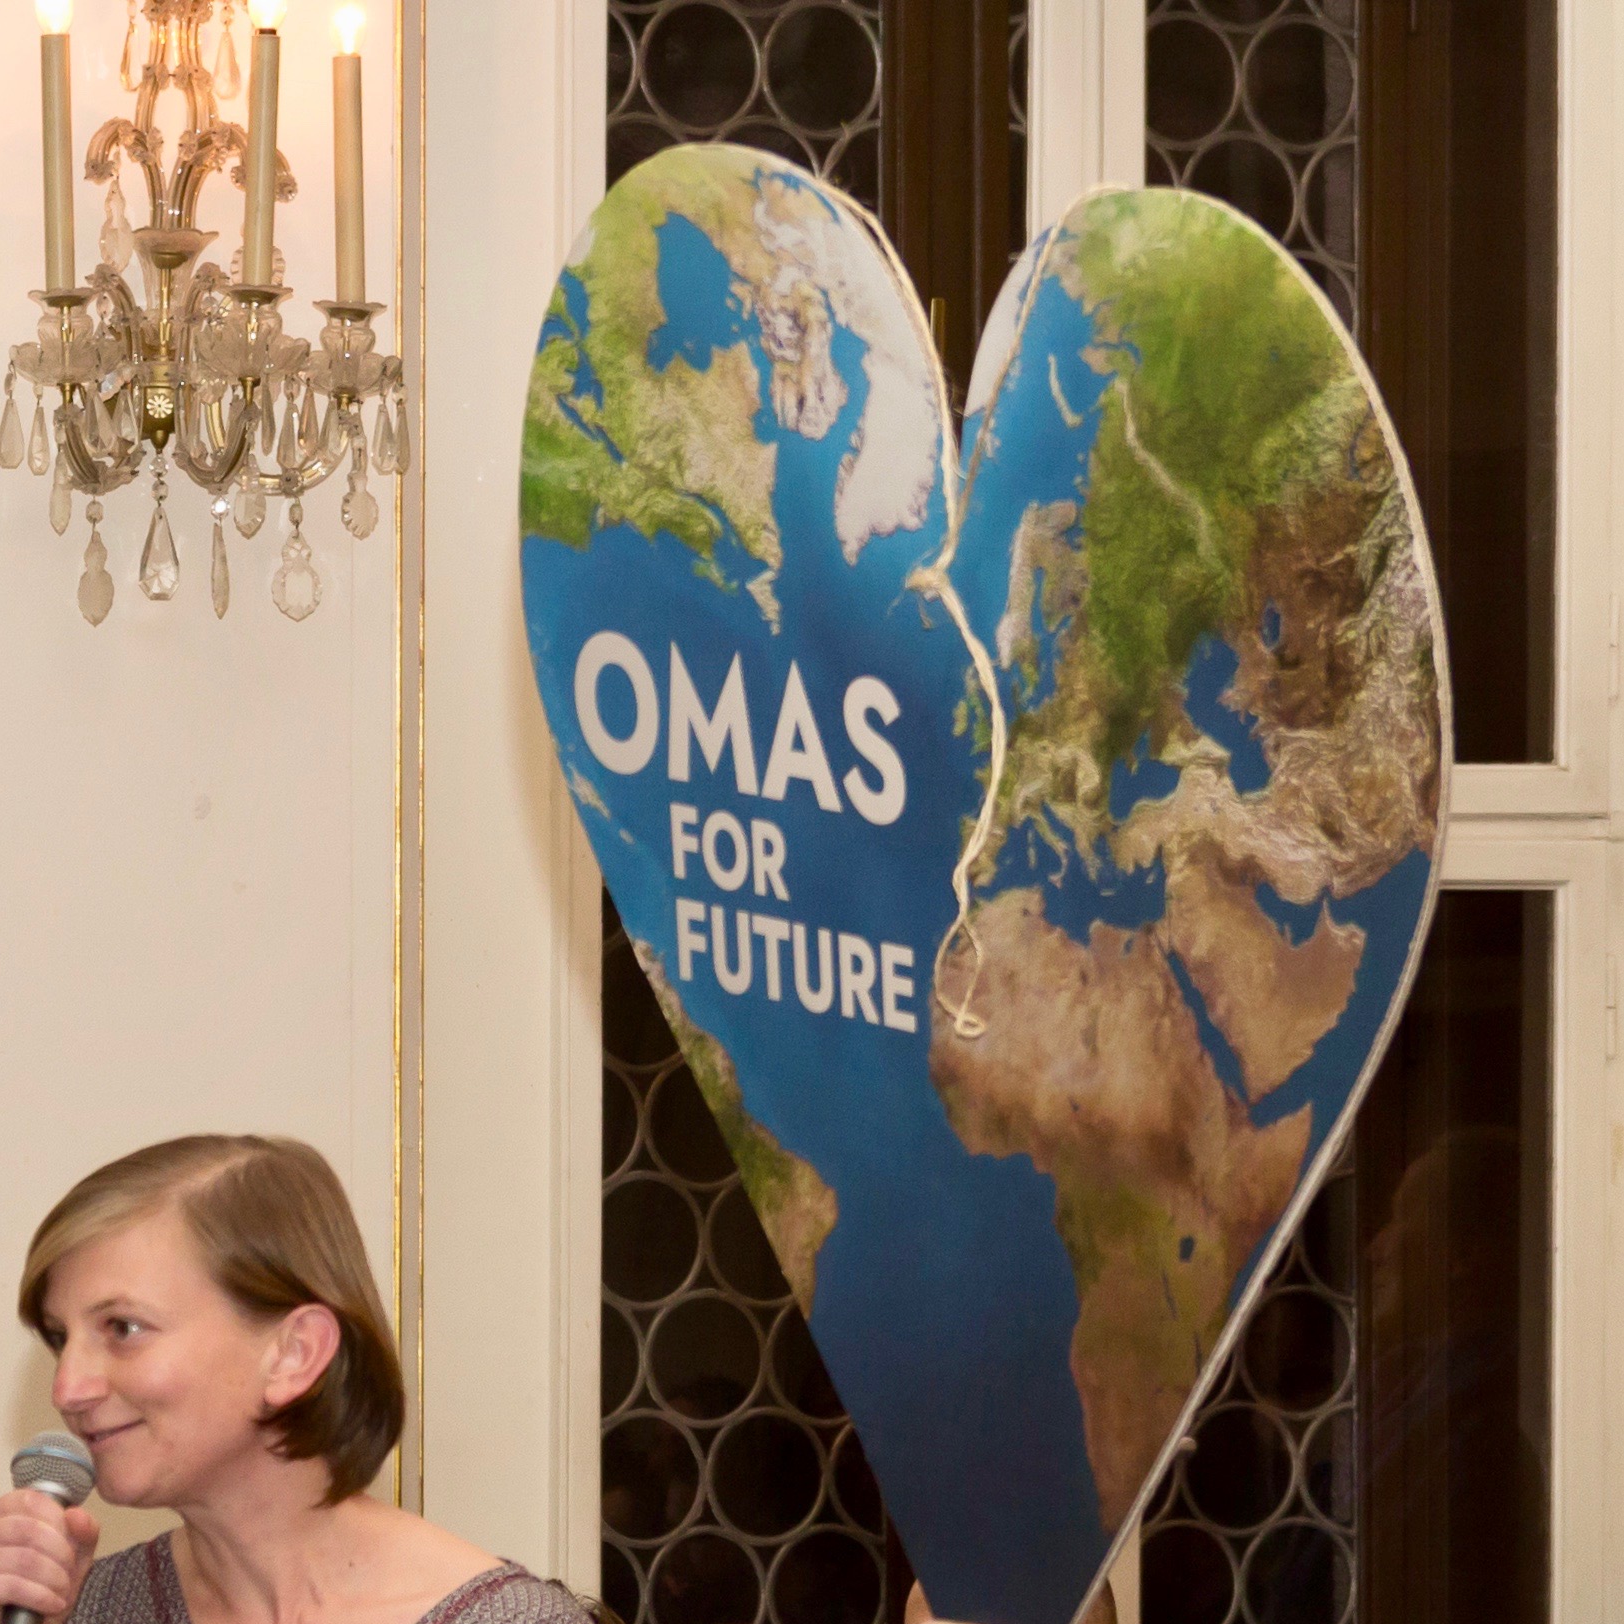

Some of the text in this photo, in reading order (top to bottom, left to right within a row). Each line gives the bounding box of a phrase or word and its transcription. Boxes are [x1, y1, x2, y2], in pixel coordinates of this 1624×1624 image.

[574, 630, 906, 825] OMAS
[669, 803, 789, 900] FOR
[675, 899, 917, 1032] FUTURE
